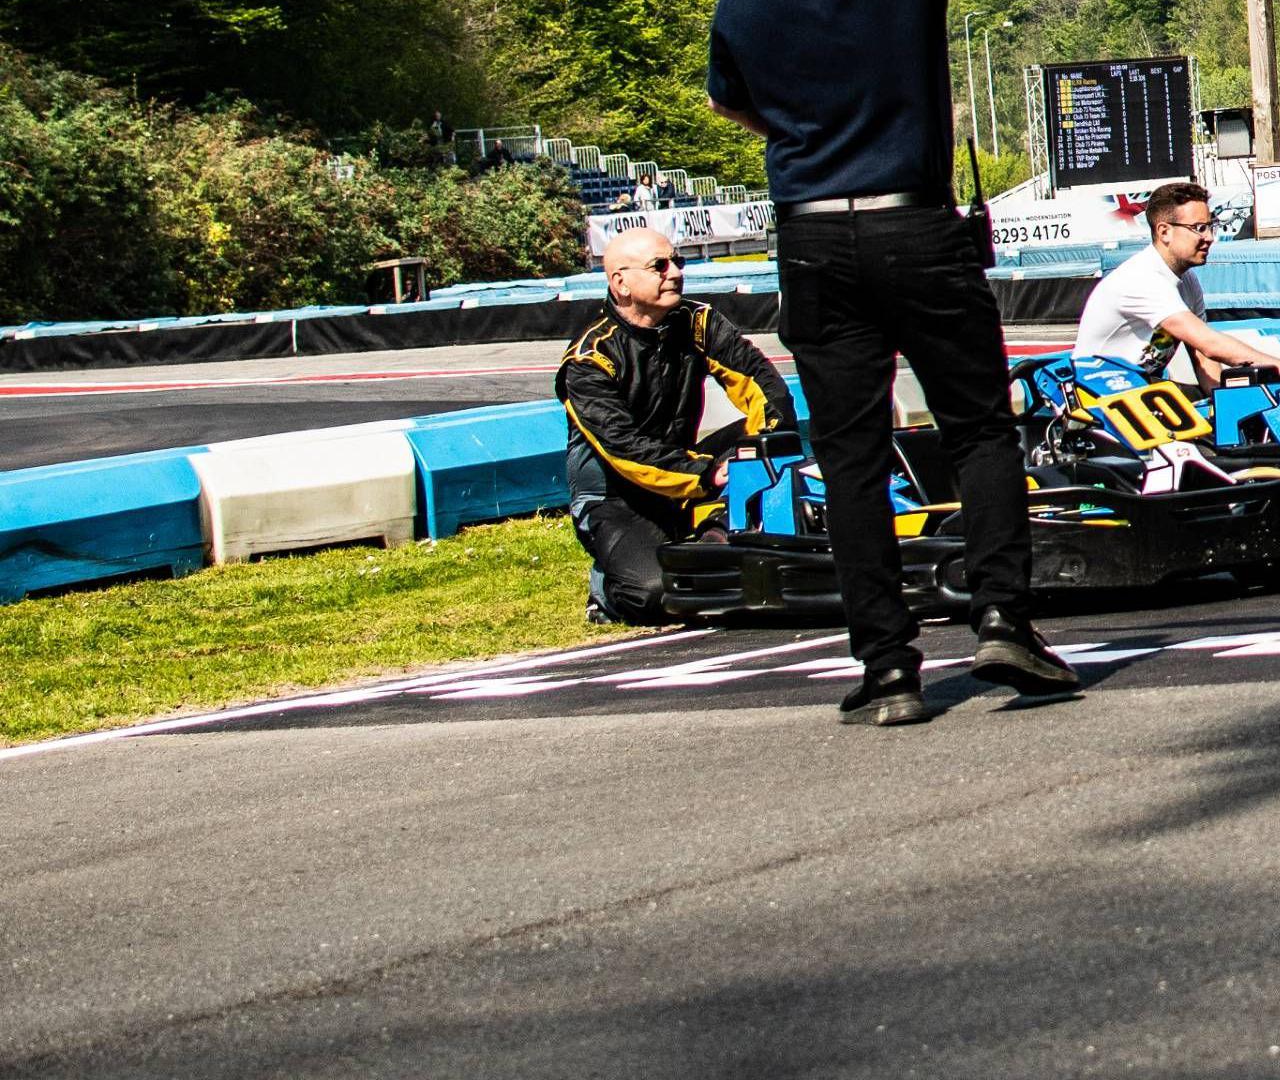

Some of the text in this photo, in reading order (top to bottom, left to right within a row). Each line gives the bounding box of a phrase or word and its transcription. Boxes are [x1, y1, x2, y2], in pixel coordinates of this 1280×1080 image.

[1257, 170, 1280, 180] POST
[1026, 213, 1071, 222] MODERNISATION
[993, 223, 1070, 244] 8293 4176
[1107, 390, 1196, 441] 10
